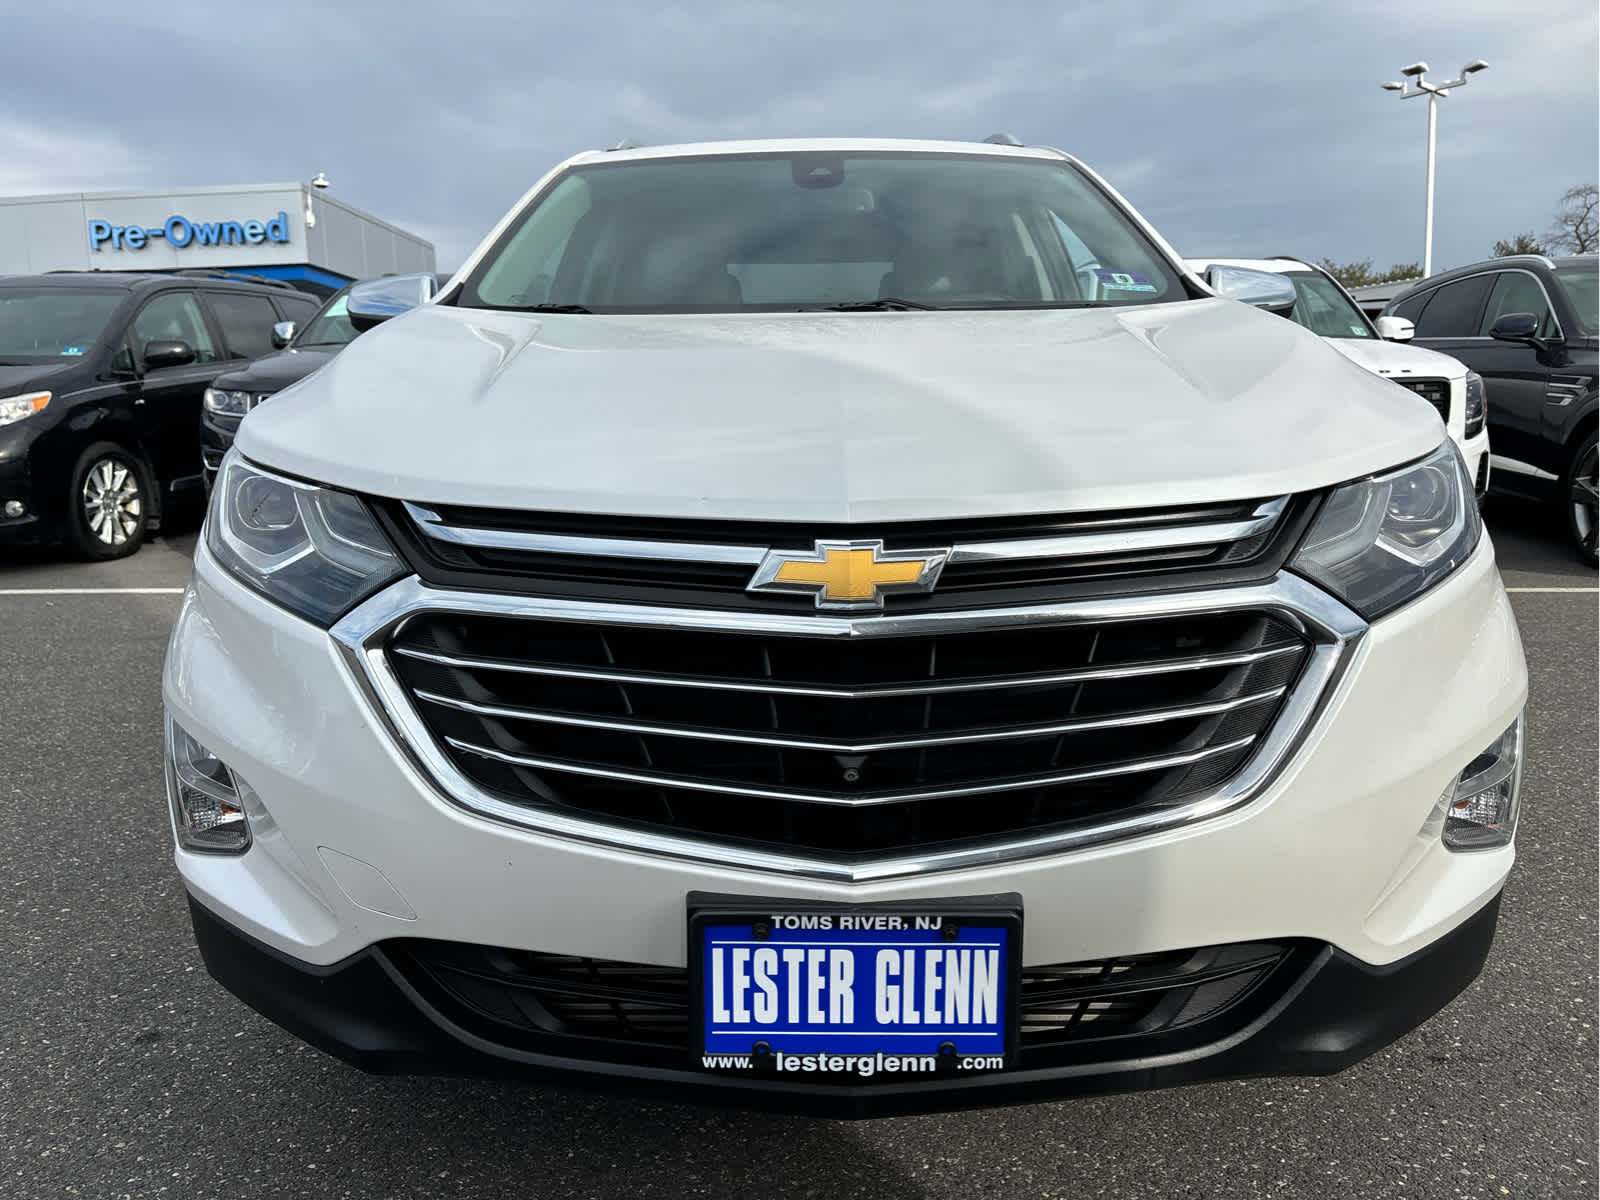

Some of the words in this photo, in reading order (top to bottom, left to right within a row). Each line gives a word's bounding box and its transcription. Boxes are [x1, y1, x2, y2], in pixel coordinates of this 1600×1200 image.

[88, 211, 290, 250] Pre-Owned
[771, 915, 833, 930] TOMS
[839, 915, 909, 931] RIVER,
[915, 916, 943, 931] NJ
[711, 947, 855, 1024] LESTER
[875, 949, 1000, 1025] GLENN
[702, 1055, 754, 1070] www.
[776, 1052, 936, 1077] lesterglenn
[956, 1056, 1004, 1070] .com
